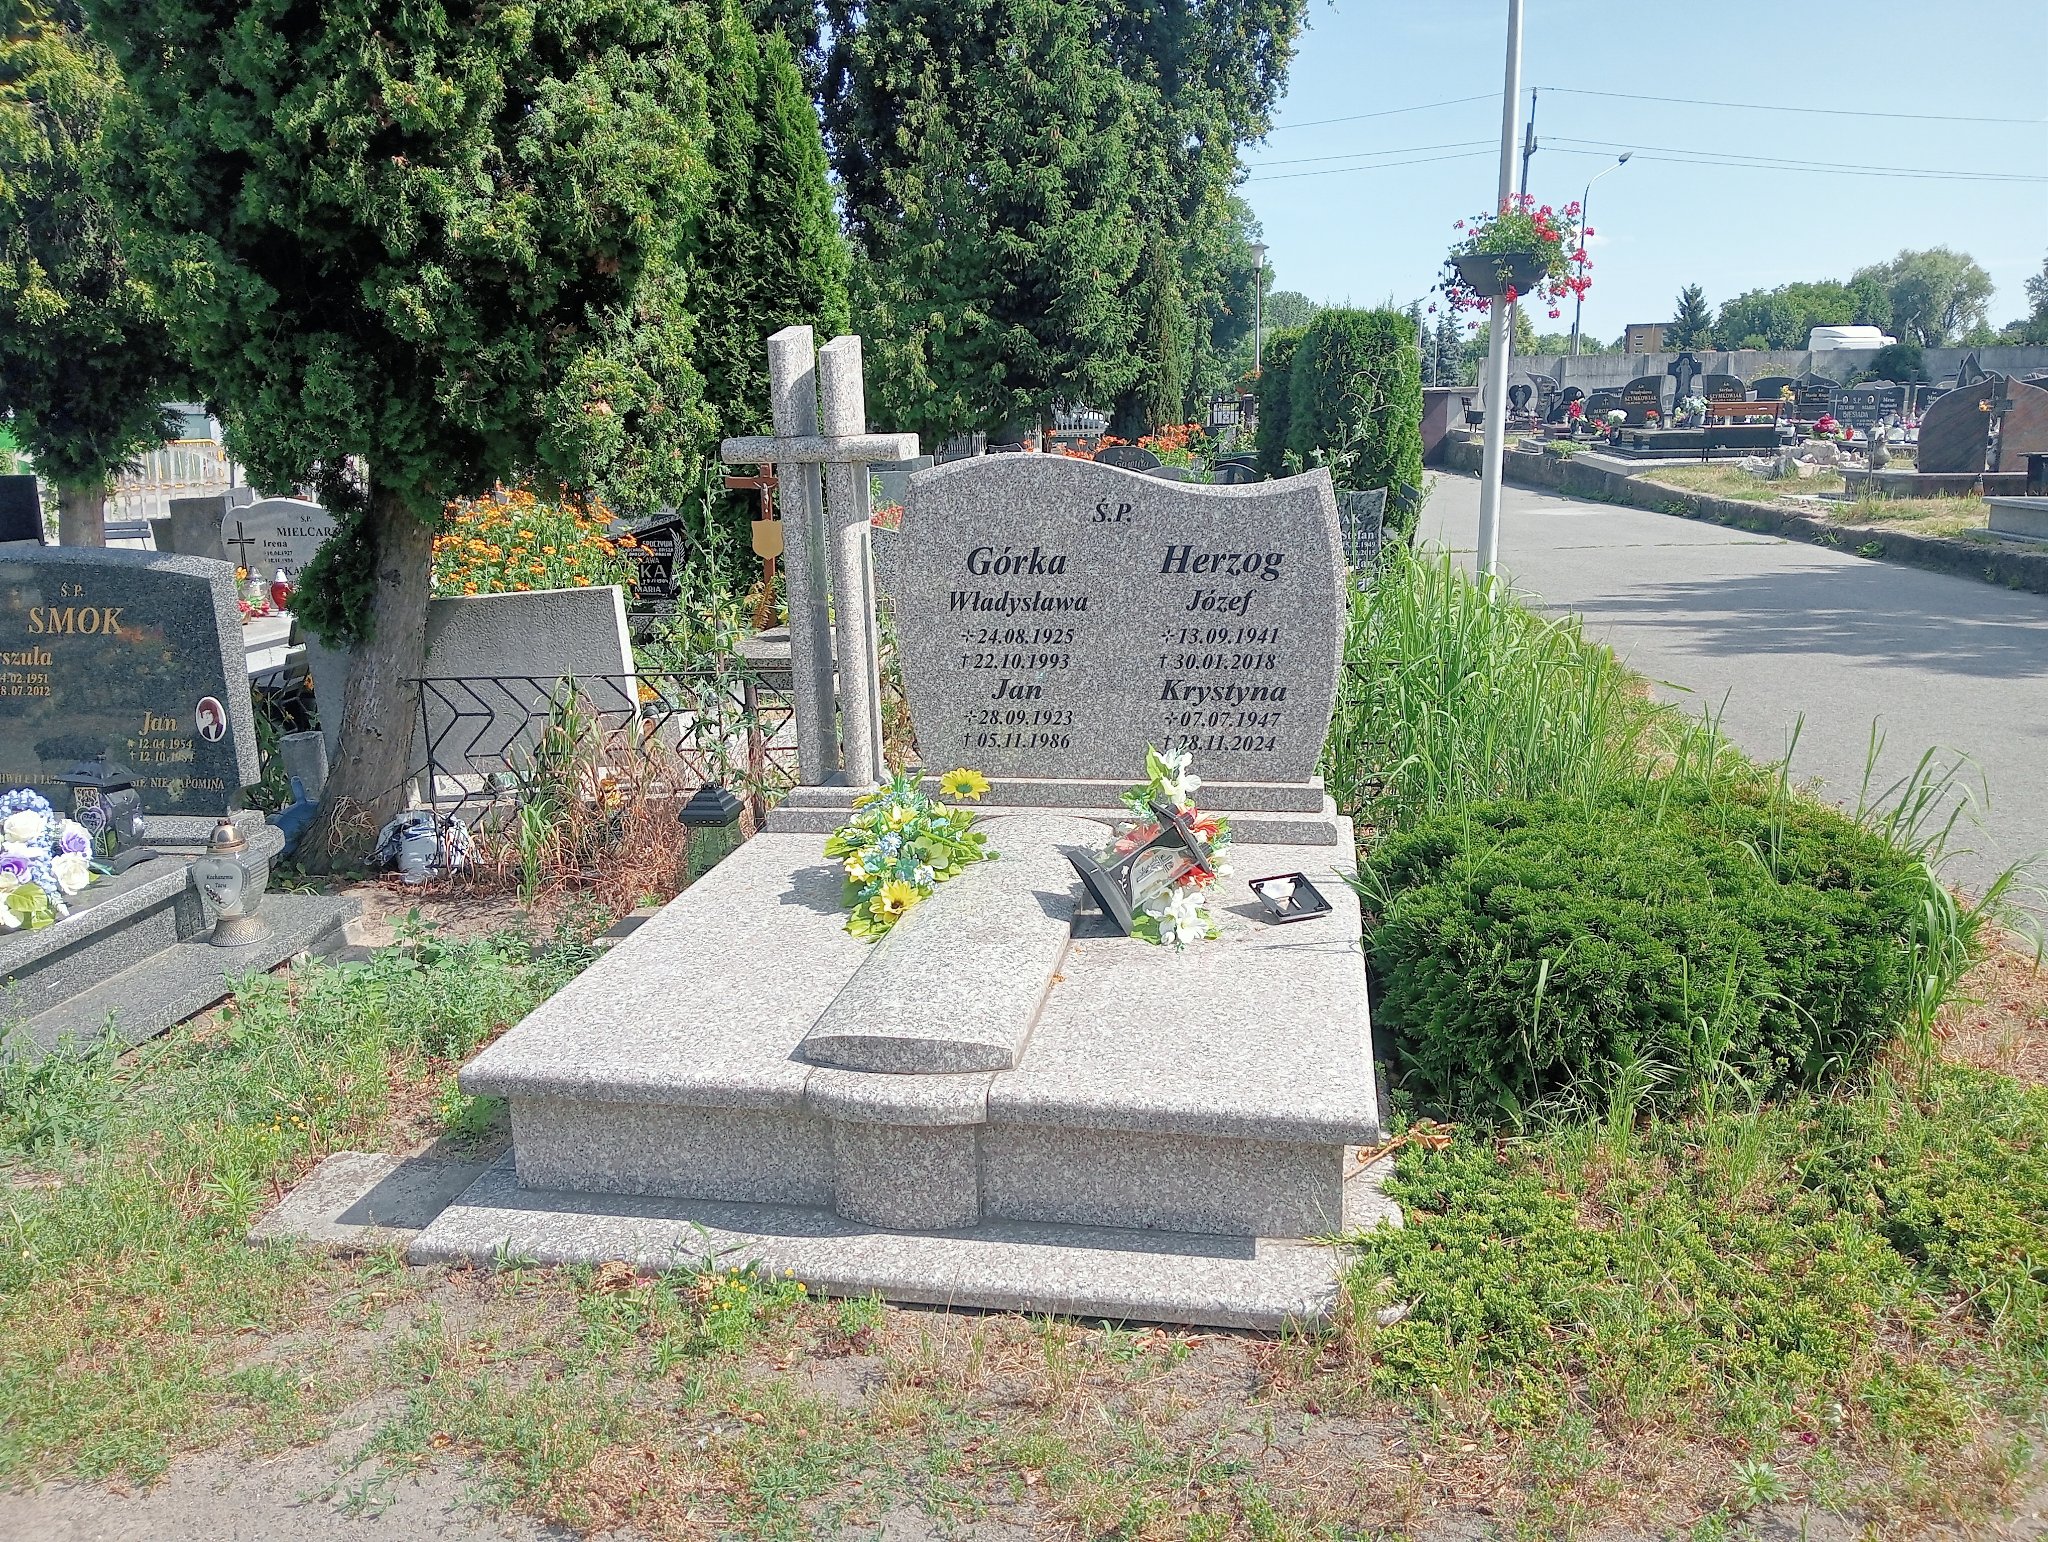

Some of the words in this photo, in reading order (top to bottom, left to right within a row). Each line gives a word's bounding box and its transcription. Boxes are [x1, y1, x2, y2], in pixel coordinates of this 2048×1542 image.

[263, 539, 288, 548] Irena
[967, 546, 1067, 575] Górka
[1158, 545, 1285, 581] Herzog
[950, 590, 1088, 617] Władysława
[1186, 589, 1257, 616] Józef
[28, 607, 124, 634] SMOK
[978, 628, 1075, 644] 24.08.1925
[1179, 628, 1279, 644] 13.09.1941
[973, 653, 1071, 669] 22.10.1993
[1174, 653, 1276, 669] 30.01.2018
[991, 678, 1042, 700] Jan
[1160, 680, 1287, 707] Krystyna
[138, 711, 178, 736] Jan
[979, 710, 1073, 725] 28.09.1923
[1180, 711, 1281, 728] 07.07.1947
[977, 733, 1070, 748] 05.11.1986
[1179, 735, 1277, 751] 28.11.2024
[150, 778, 168, 788] NIE
[170, 778, 225, 790] APOMINA
